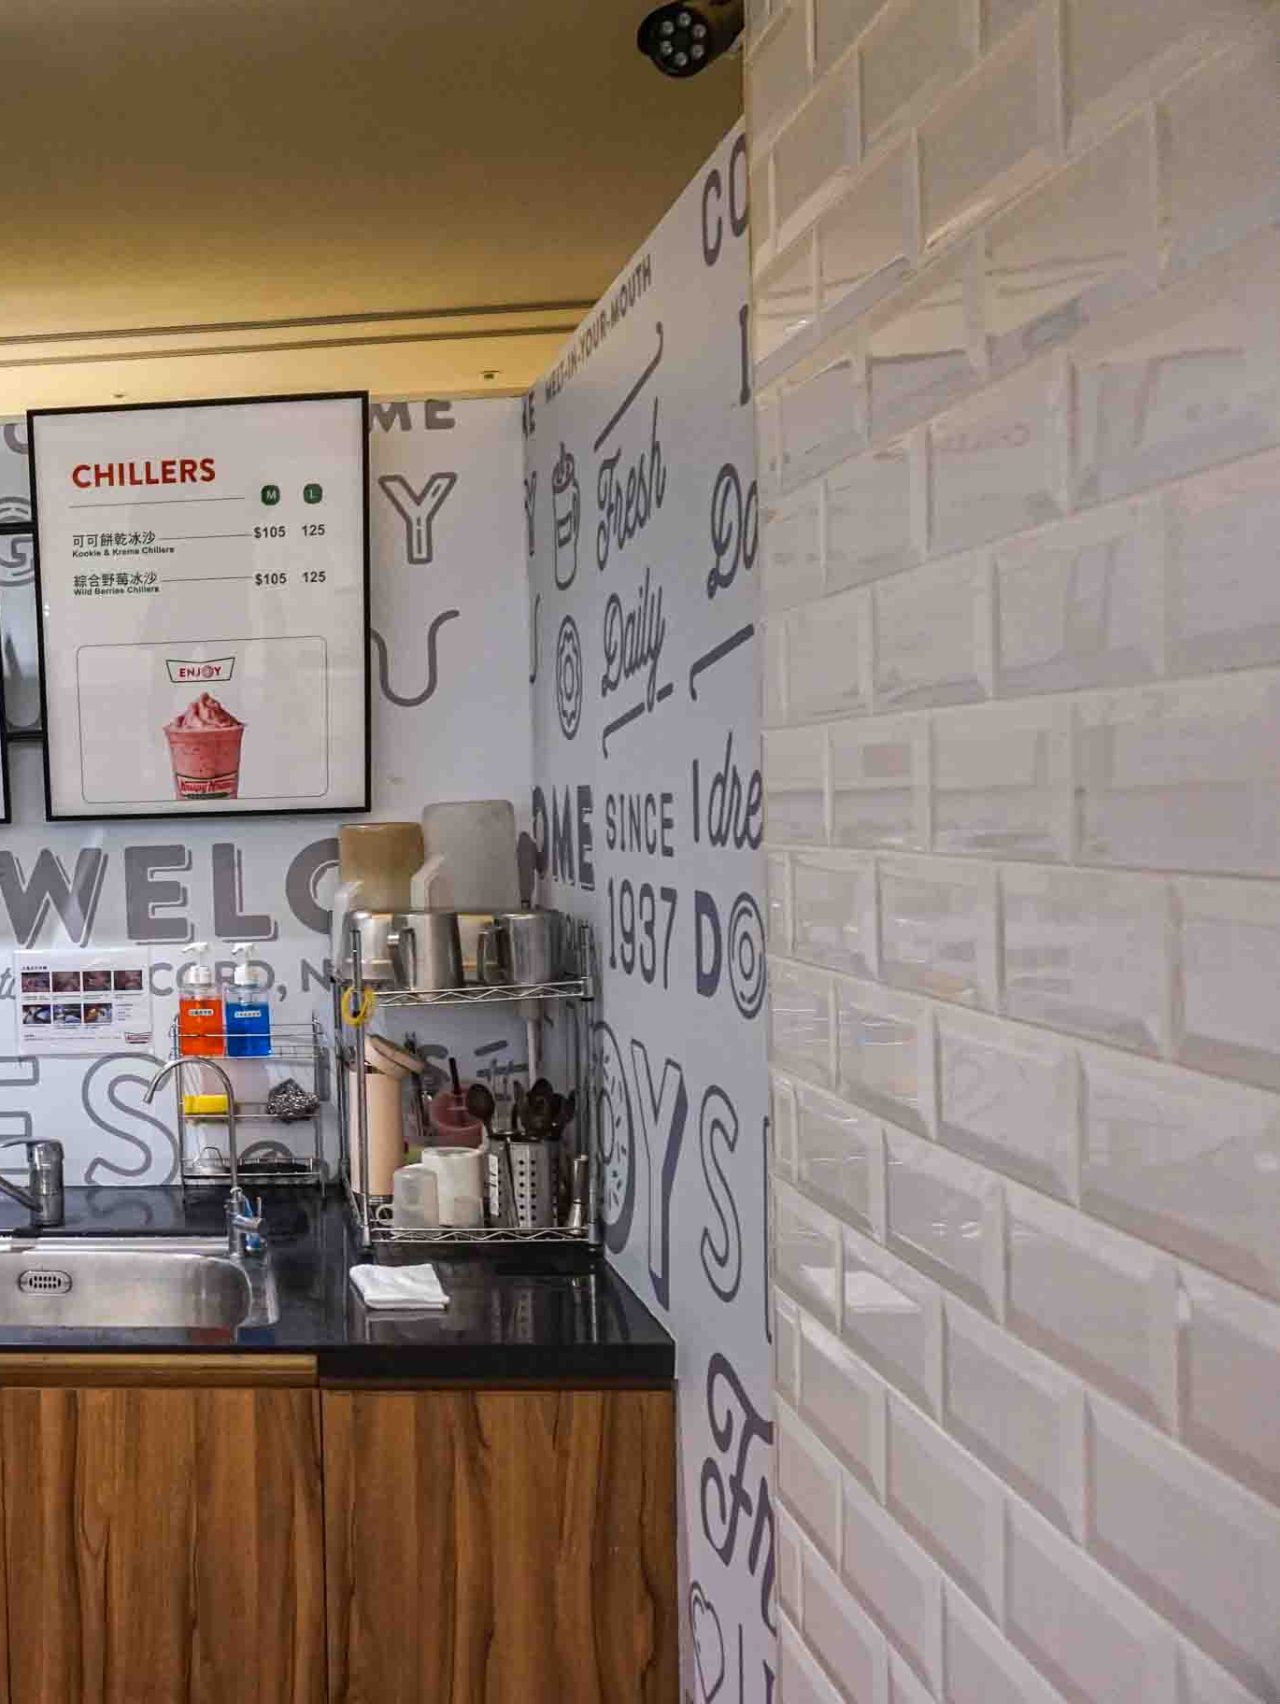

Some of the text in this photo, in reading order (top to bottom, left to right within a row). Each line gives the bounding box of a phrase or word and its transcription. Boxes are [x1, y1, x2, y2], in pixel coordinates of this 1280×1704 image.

[72, 458, 216, 489] CHILLERS
[596, 396, 666, 571] Fresh
[72, 524, 326, 548] 可可餅乾冰沙 $105 125
[142, 545, 175, 556] Chillers
[73, 571, 326, 588] 綜合野莓冰沙 $105 125
[602, 567, 665, 713] Daily
[179, 665, 222, 679] ENJOY
[605, 792, 674, 858] SINCE
[607, 878, 678, 990] 1937
